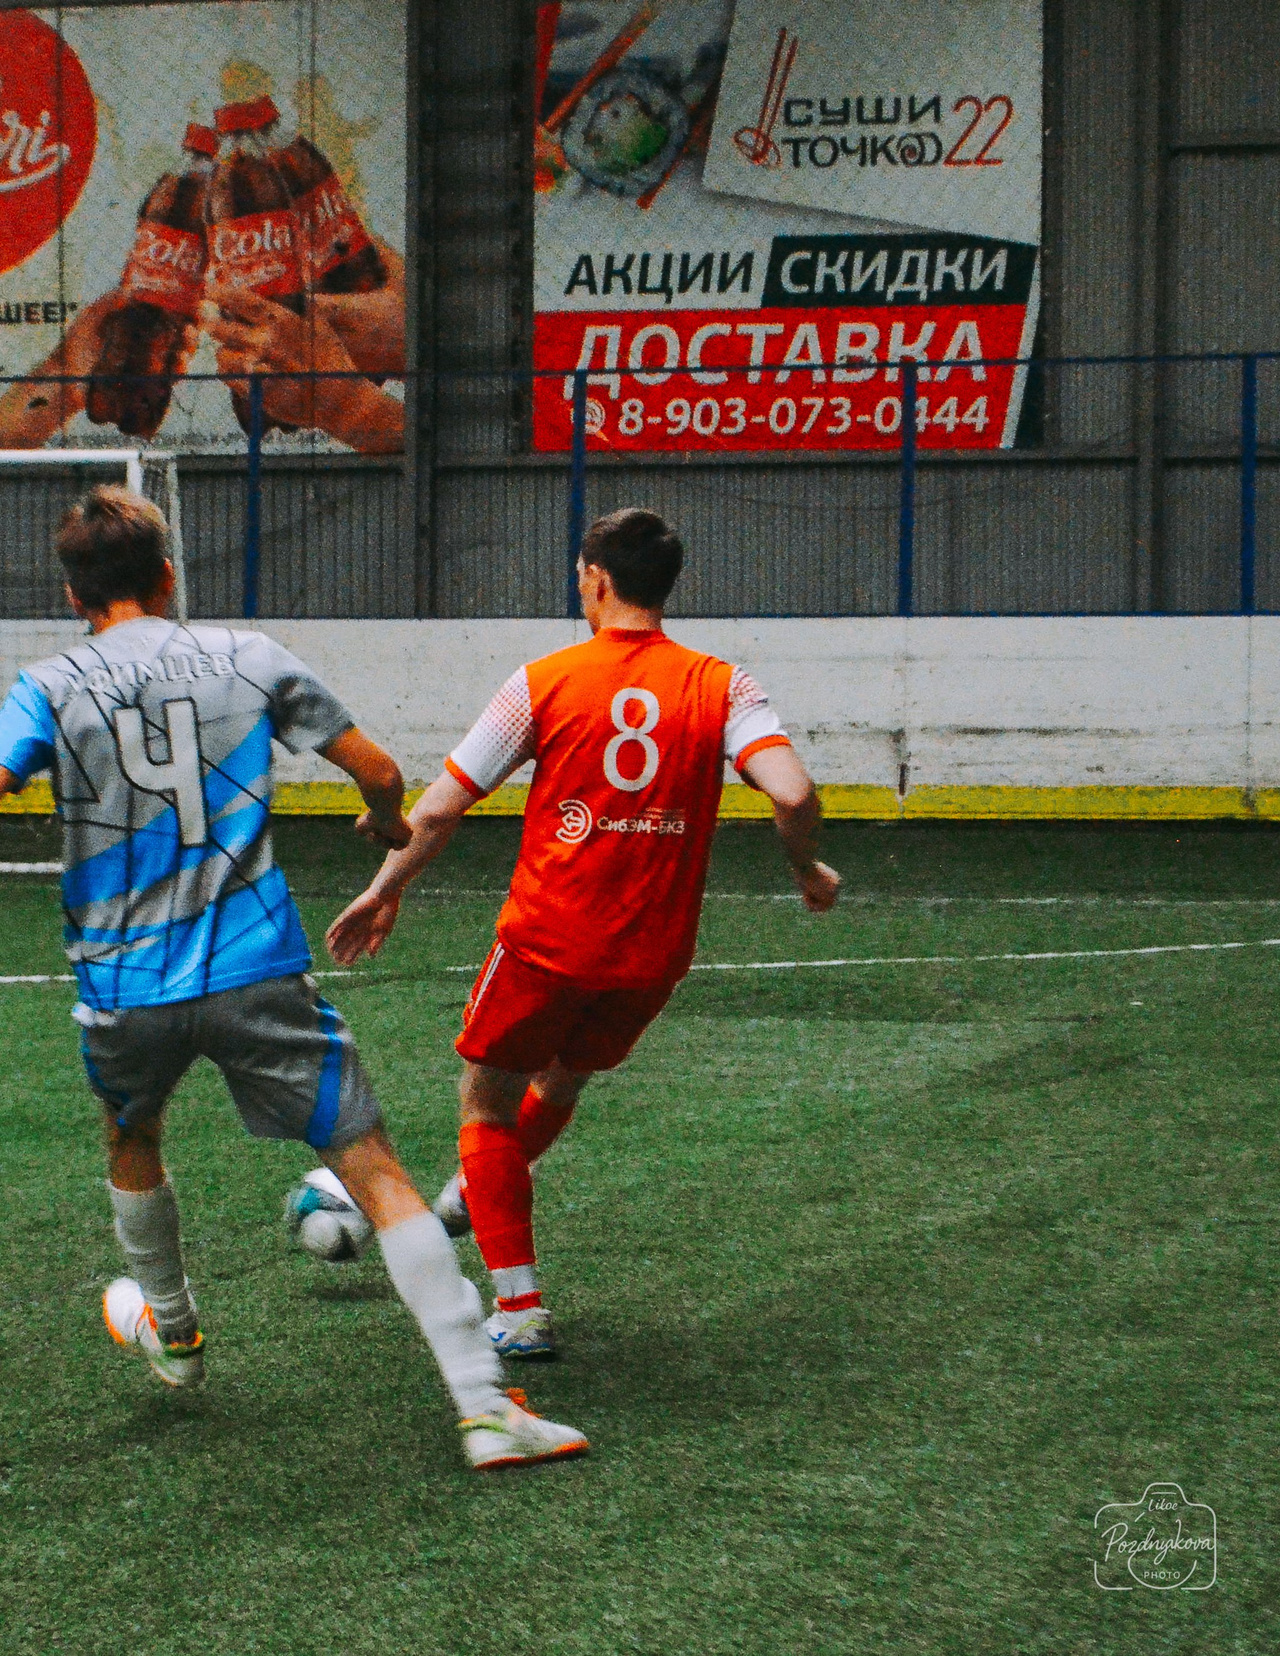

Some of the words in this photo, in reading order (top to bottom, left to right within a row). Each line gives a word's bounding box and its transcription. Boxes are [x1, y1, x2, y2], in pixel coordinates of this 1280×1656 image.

[783, 96, 941, 126] СУШИ
[943, 95, 1013, 166] 22
[564, 252, 754, 304] АКЦИИ
[780, 248, 1008, 301] СКИДКИ
[563, 320, 989, 400] ДОСТАВКА
[113, 696, 207, 848] 4
[603, 687, 661, 792] 8
